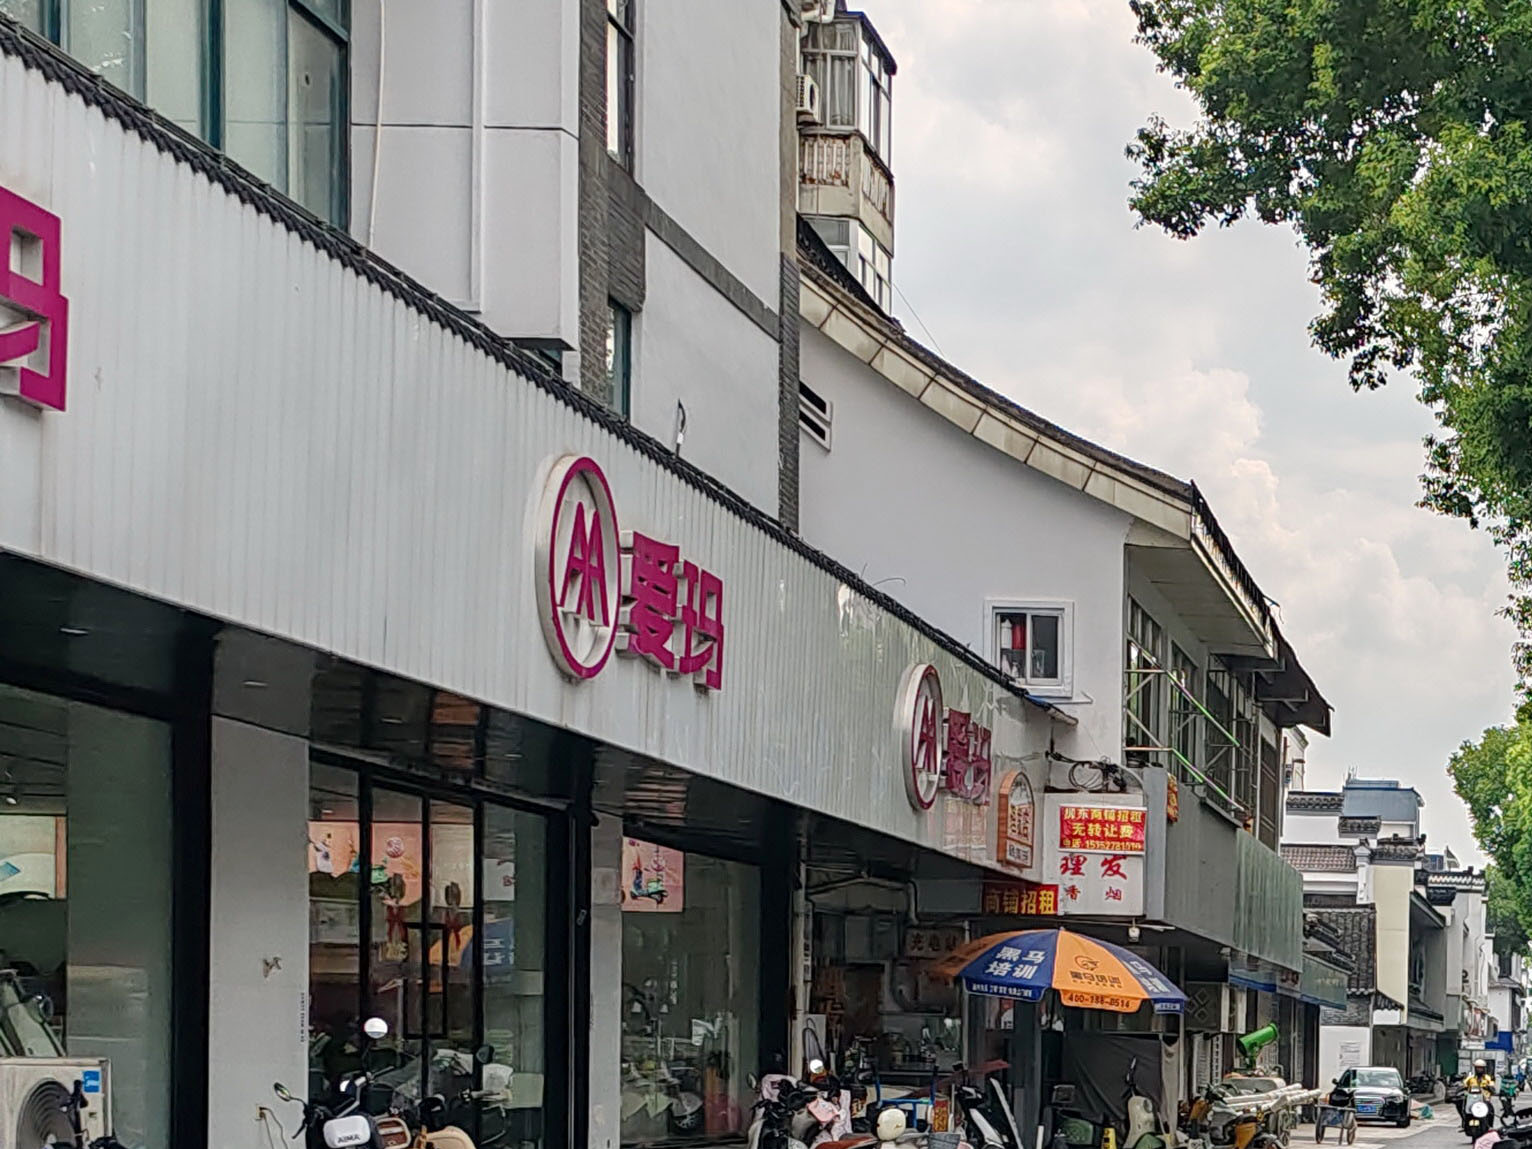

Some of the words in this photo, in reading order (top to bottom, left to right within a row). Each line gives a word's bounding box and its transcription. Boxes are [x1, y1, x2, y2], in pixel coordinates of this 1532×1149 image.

[629, 531, 725, 692] 爱玛
[1072, 823, 1134, 838] 无转让费
[1060, 854, 1128, 880] 理发
[986, 889, 1055, 914] 商铺招租
[1064, 884, 1122, 901] 香烟
[995, 946, 1046, 964] 黑马
[985, 961, 1038, 980] 培训
[337, 1134, 361, 1144] AIMA
